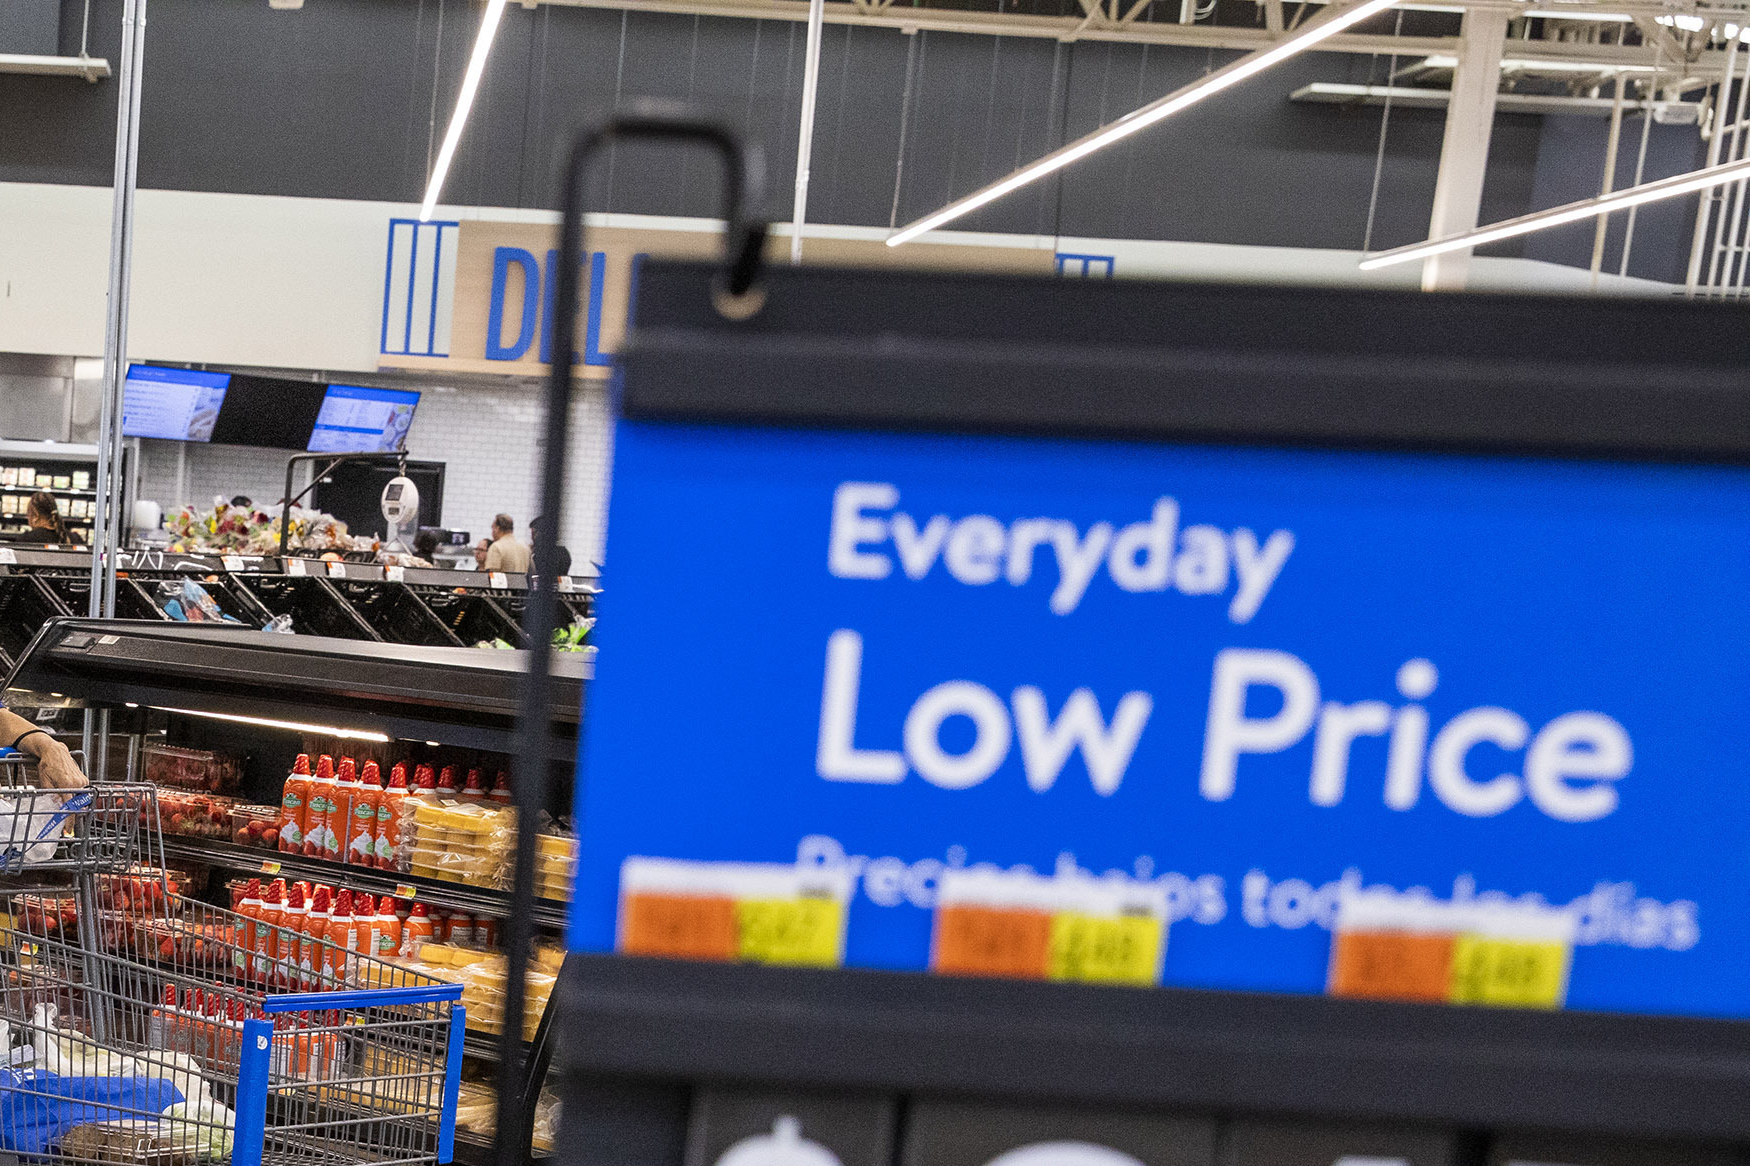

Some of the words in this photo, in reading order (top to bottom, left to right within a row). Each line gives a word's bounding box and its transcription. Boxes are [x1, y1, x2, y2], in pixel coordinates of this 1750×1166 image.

[827, 480, 1297, 624] Everyday
[814, 628, 1155, 798] Low
[1198, 647, 1636, 824] Price
